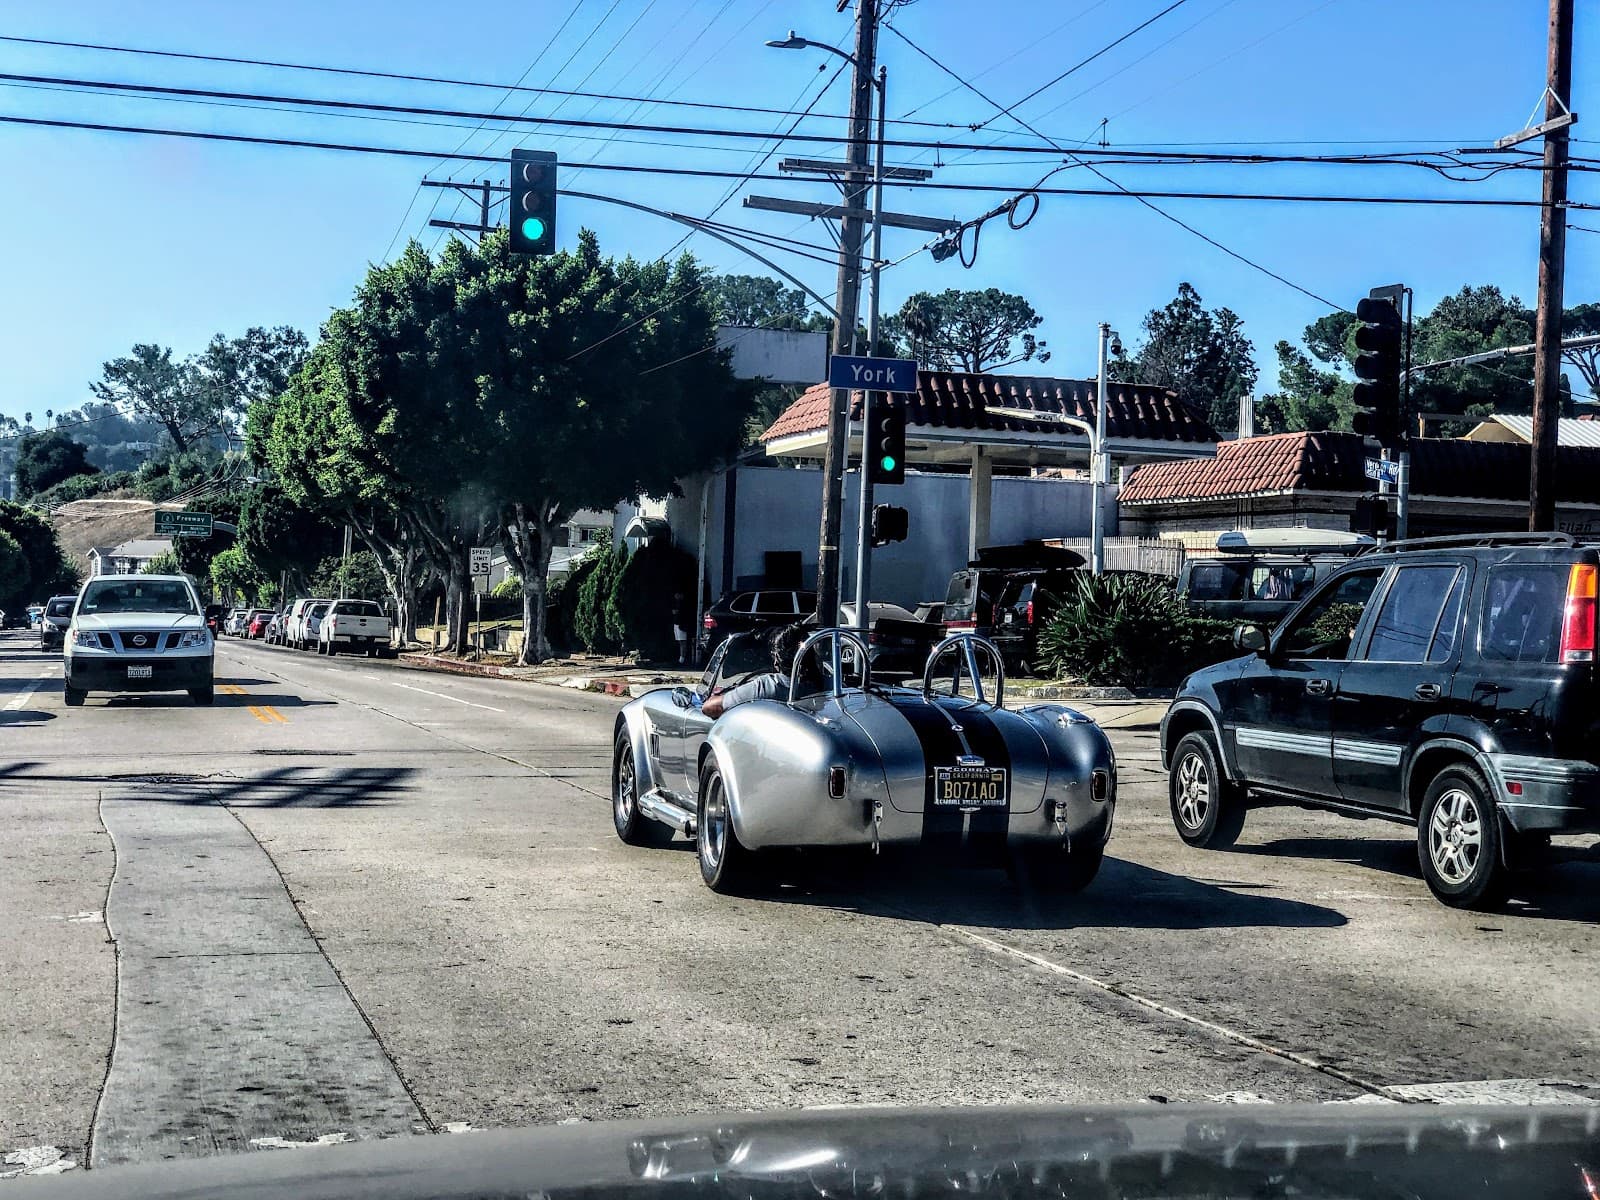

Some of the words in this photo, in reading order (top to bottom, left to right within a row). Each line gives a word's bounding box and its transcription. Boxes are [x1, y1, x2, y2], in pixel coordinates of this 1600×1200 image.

[851, 364, 896, 384] York
[176, 515, 205, 523] Freeway
[473, 562, 489, 572] 35
